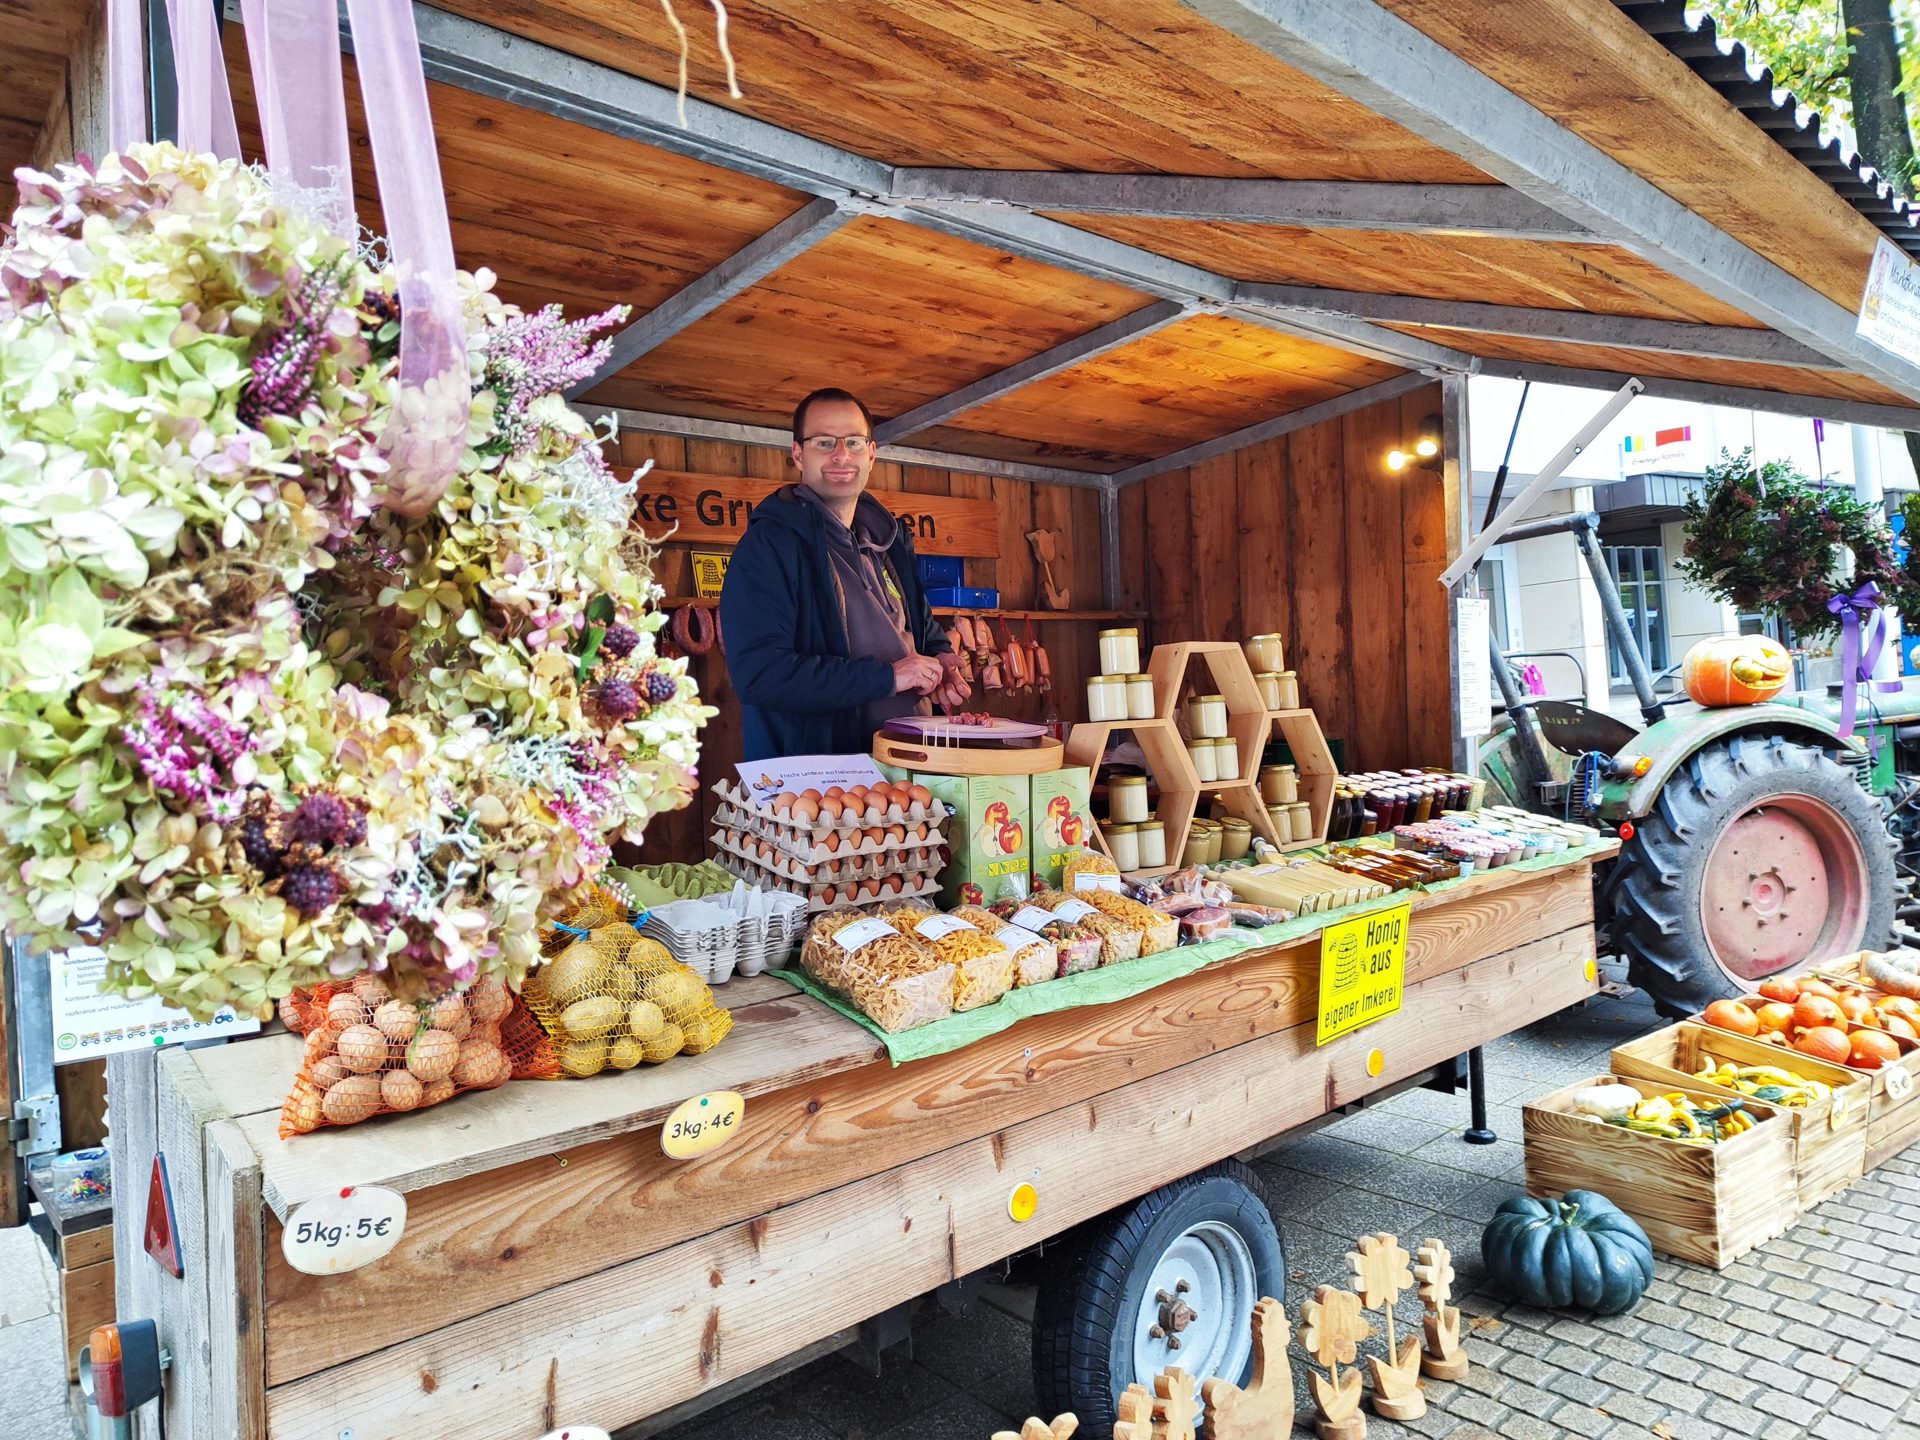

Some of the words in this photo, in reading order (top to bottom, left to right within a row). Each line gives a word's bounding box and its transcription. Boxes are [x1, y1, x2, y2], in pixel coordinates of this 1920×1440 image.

[634, 493, 677, 523] ke
[1366, 914, 1401, 948] Honig
[1370, 949, 1392, 975] aus
[1324, 998, 1359, 1029] eigener
[1361, 981, 1397, 1012] Imkerei
